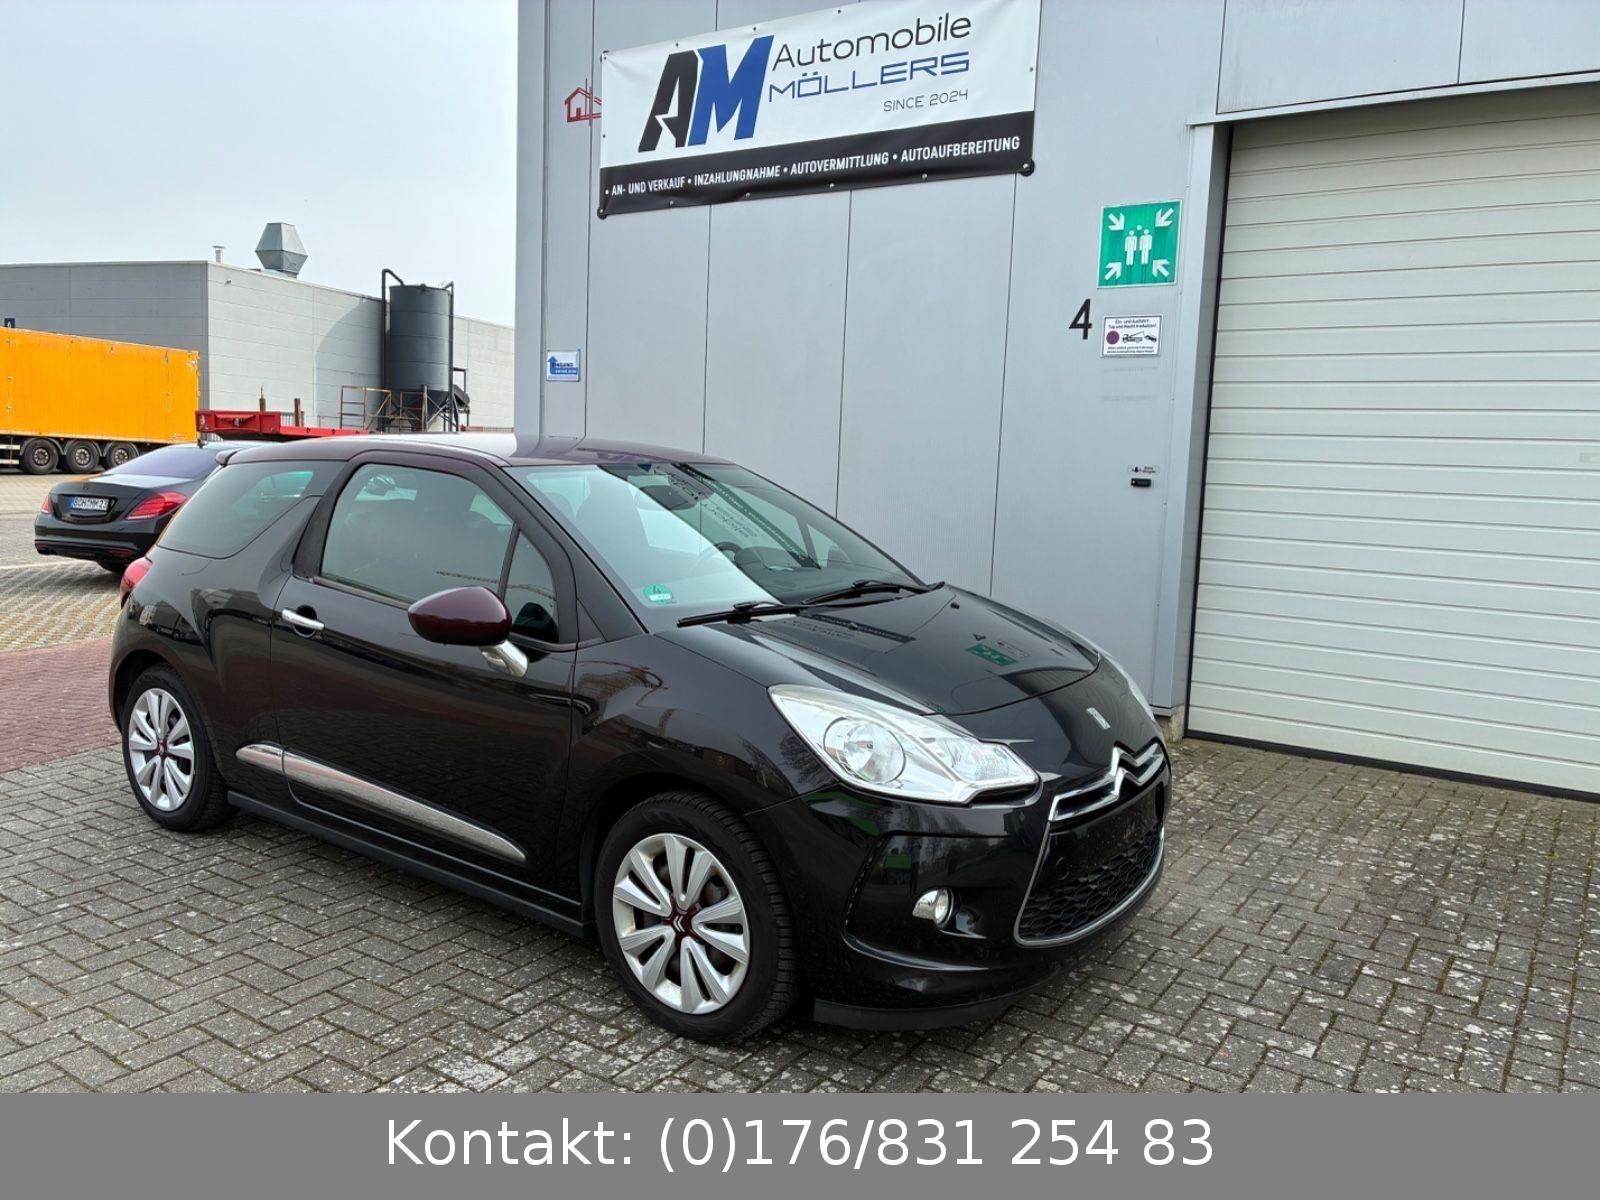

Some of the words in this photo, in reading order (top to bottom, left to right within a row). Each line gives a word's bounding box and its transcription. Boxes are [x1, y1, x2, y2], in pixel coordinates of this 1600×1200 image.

[772, 13, 972, 71] Automobile
[638, 34, 775, 153] AM
[769, 51, 970, 103] MÖLLERS
[883, 95, 925, 112] SINCE
[929, 89, 969, 106] 2024
[611, 184, 627, 196] AN-
[628, 181, 647, 194] UND
[648, 176, 685, 191] VERKAUF
[694, 165, 781, 186] INZAHLUNGNAHME
[790, 152, 889, 175] AUTOVERMITTLUNG
[900, 136, 1020, 162] AUTOAUFBEREITUNG
[1068, 298, 1093, 340] 4
